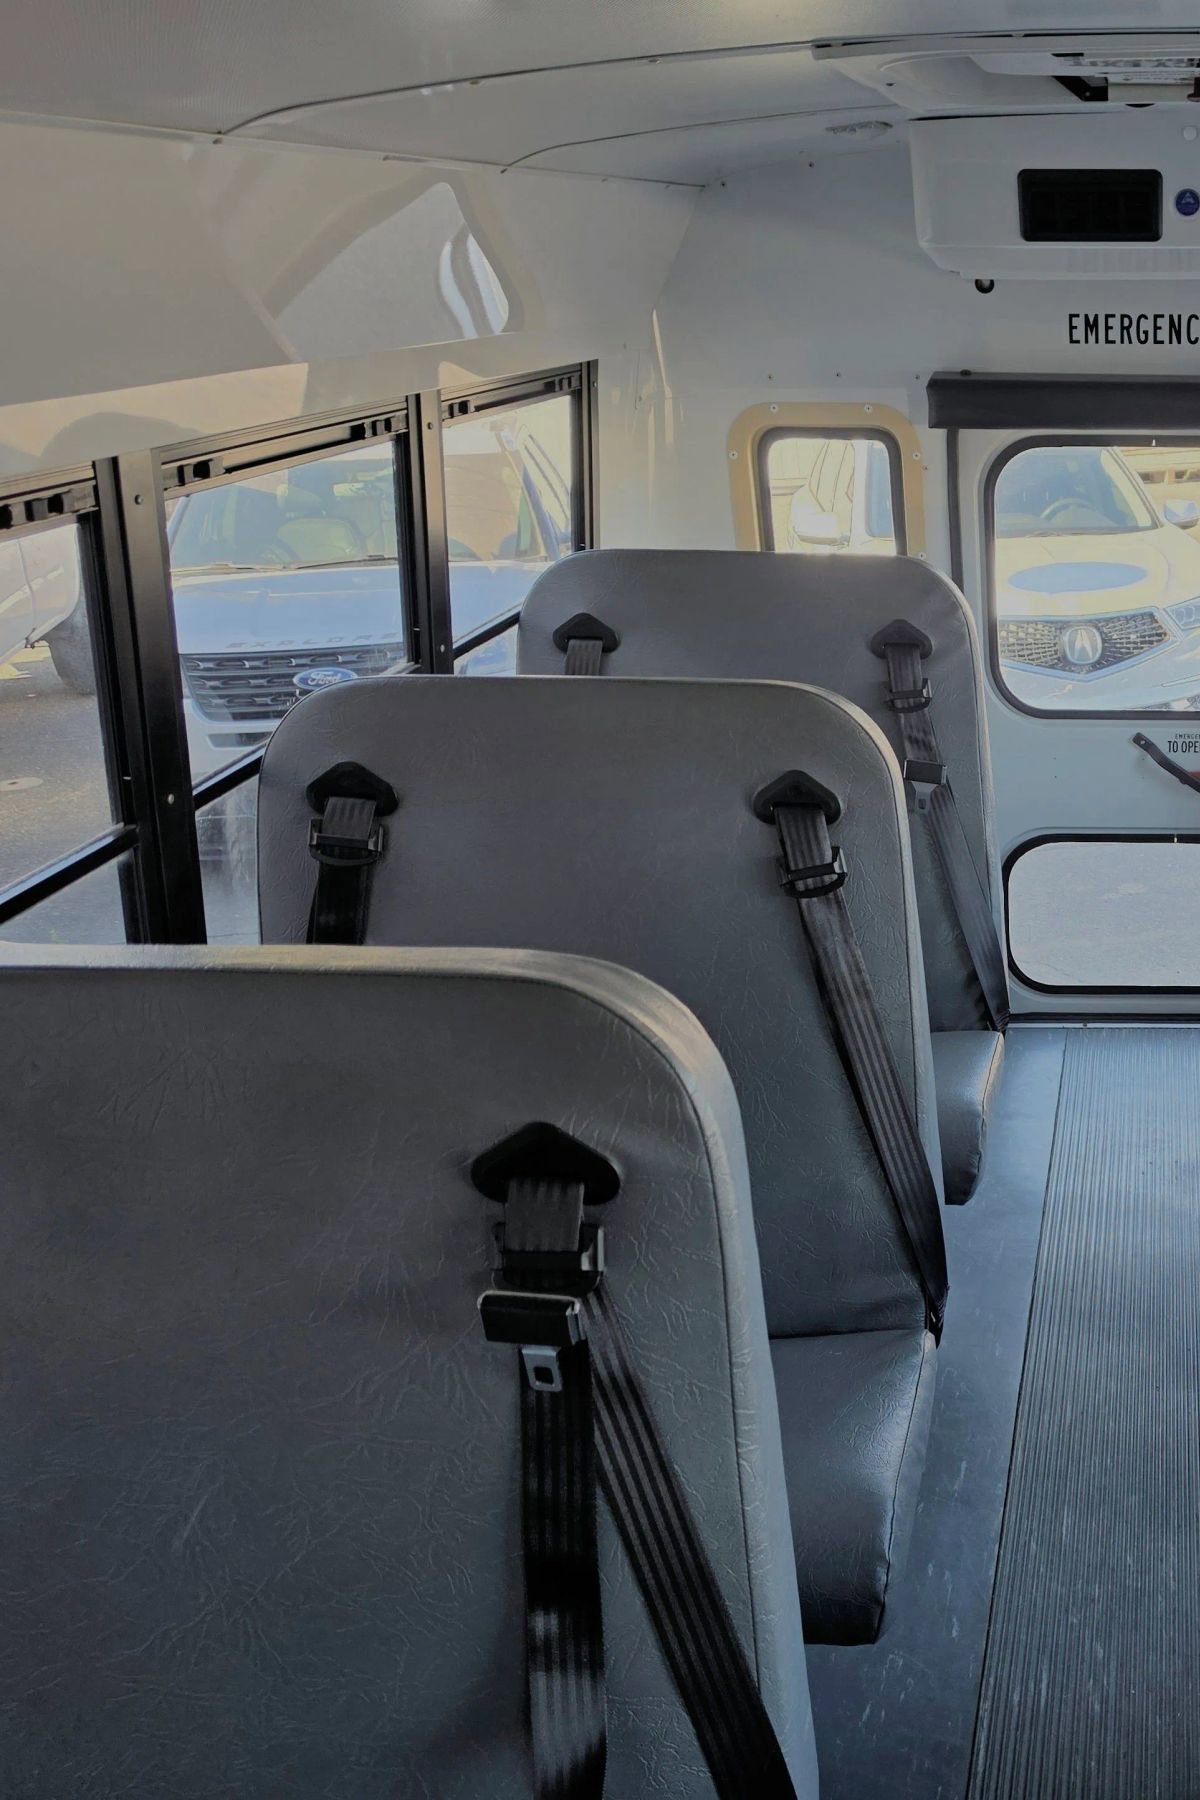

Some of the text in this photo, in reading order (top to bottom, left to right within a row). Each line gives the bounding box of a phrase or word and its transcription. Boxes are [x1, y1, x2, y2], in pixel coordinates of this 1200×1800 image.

[226, 632, 399, 648] EXPLORE
[307, 671, 342, 685] Ford
[1167, 740, 1179, 753] TO
